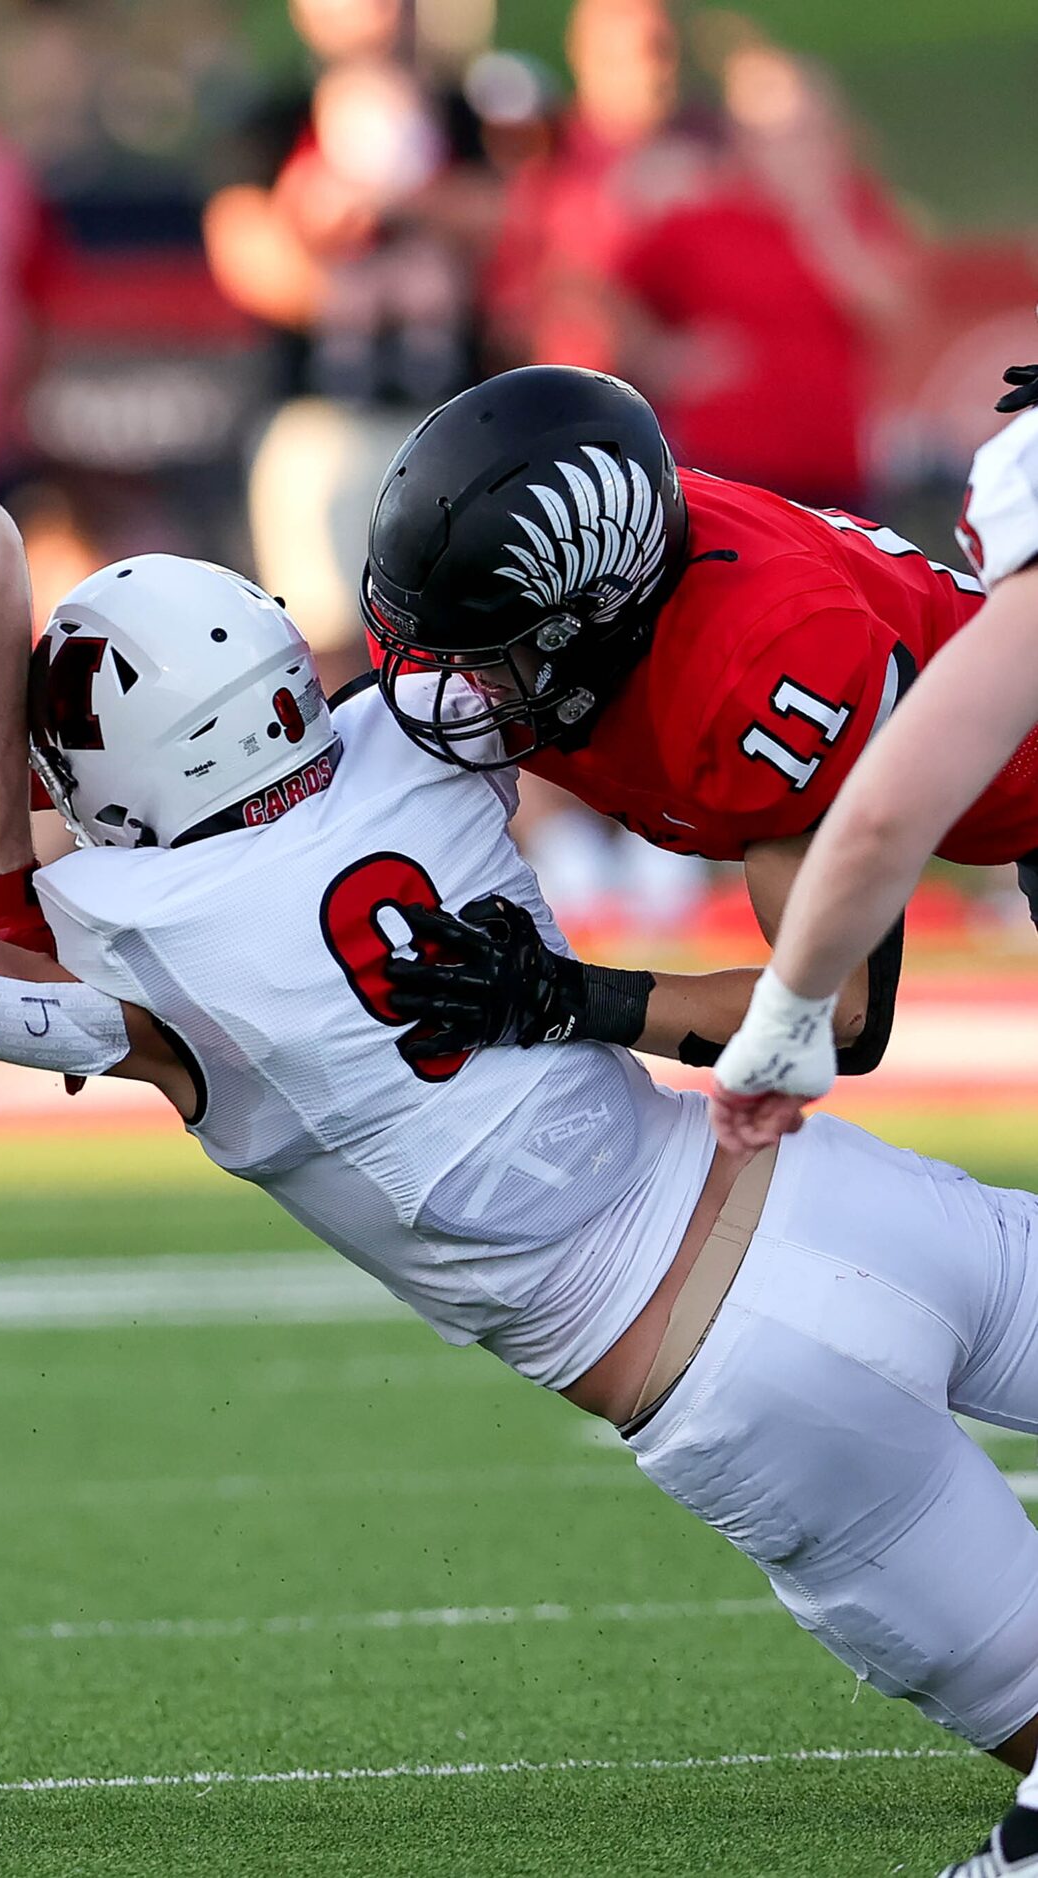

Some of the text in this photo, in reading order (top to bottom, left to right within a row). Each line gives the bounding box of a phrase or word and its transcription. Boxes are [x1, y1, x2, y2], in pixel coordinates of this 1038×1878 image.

[271, 686, 307, 745] 9
[740, 675, 853, 792] 11
[241, 756, 333, 828] CARDS
